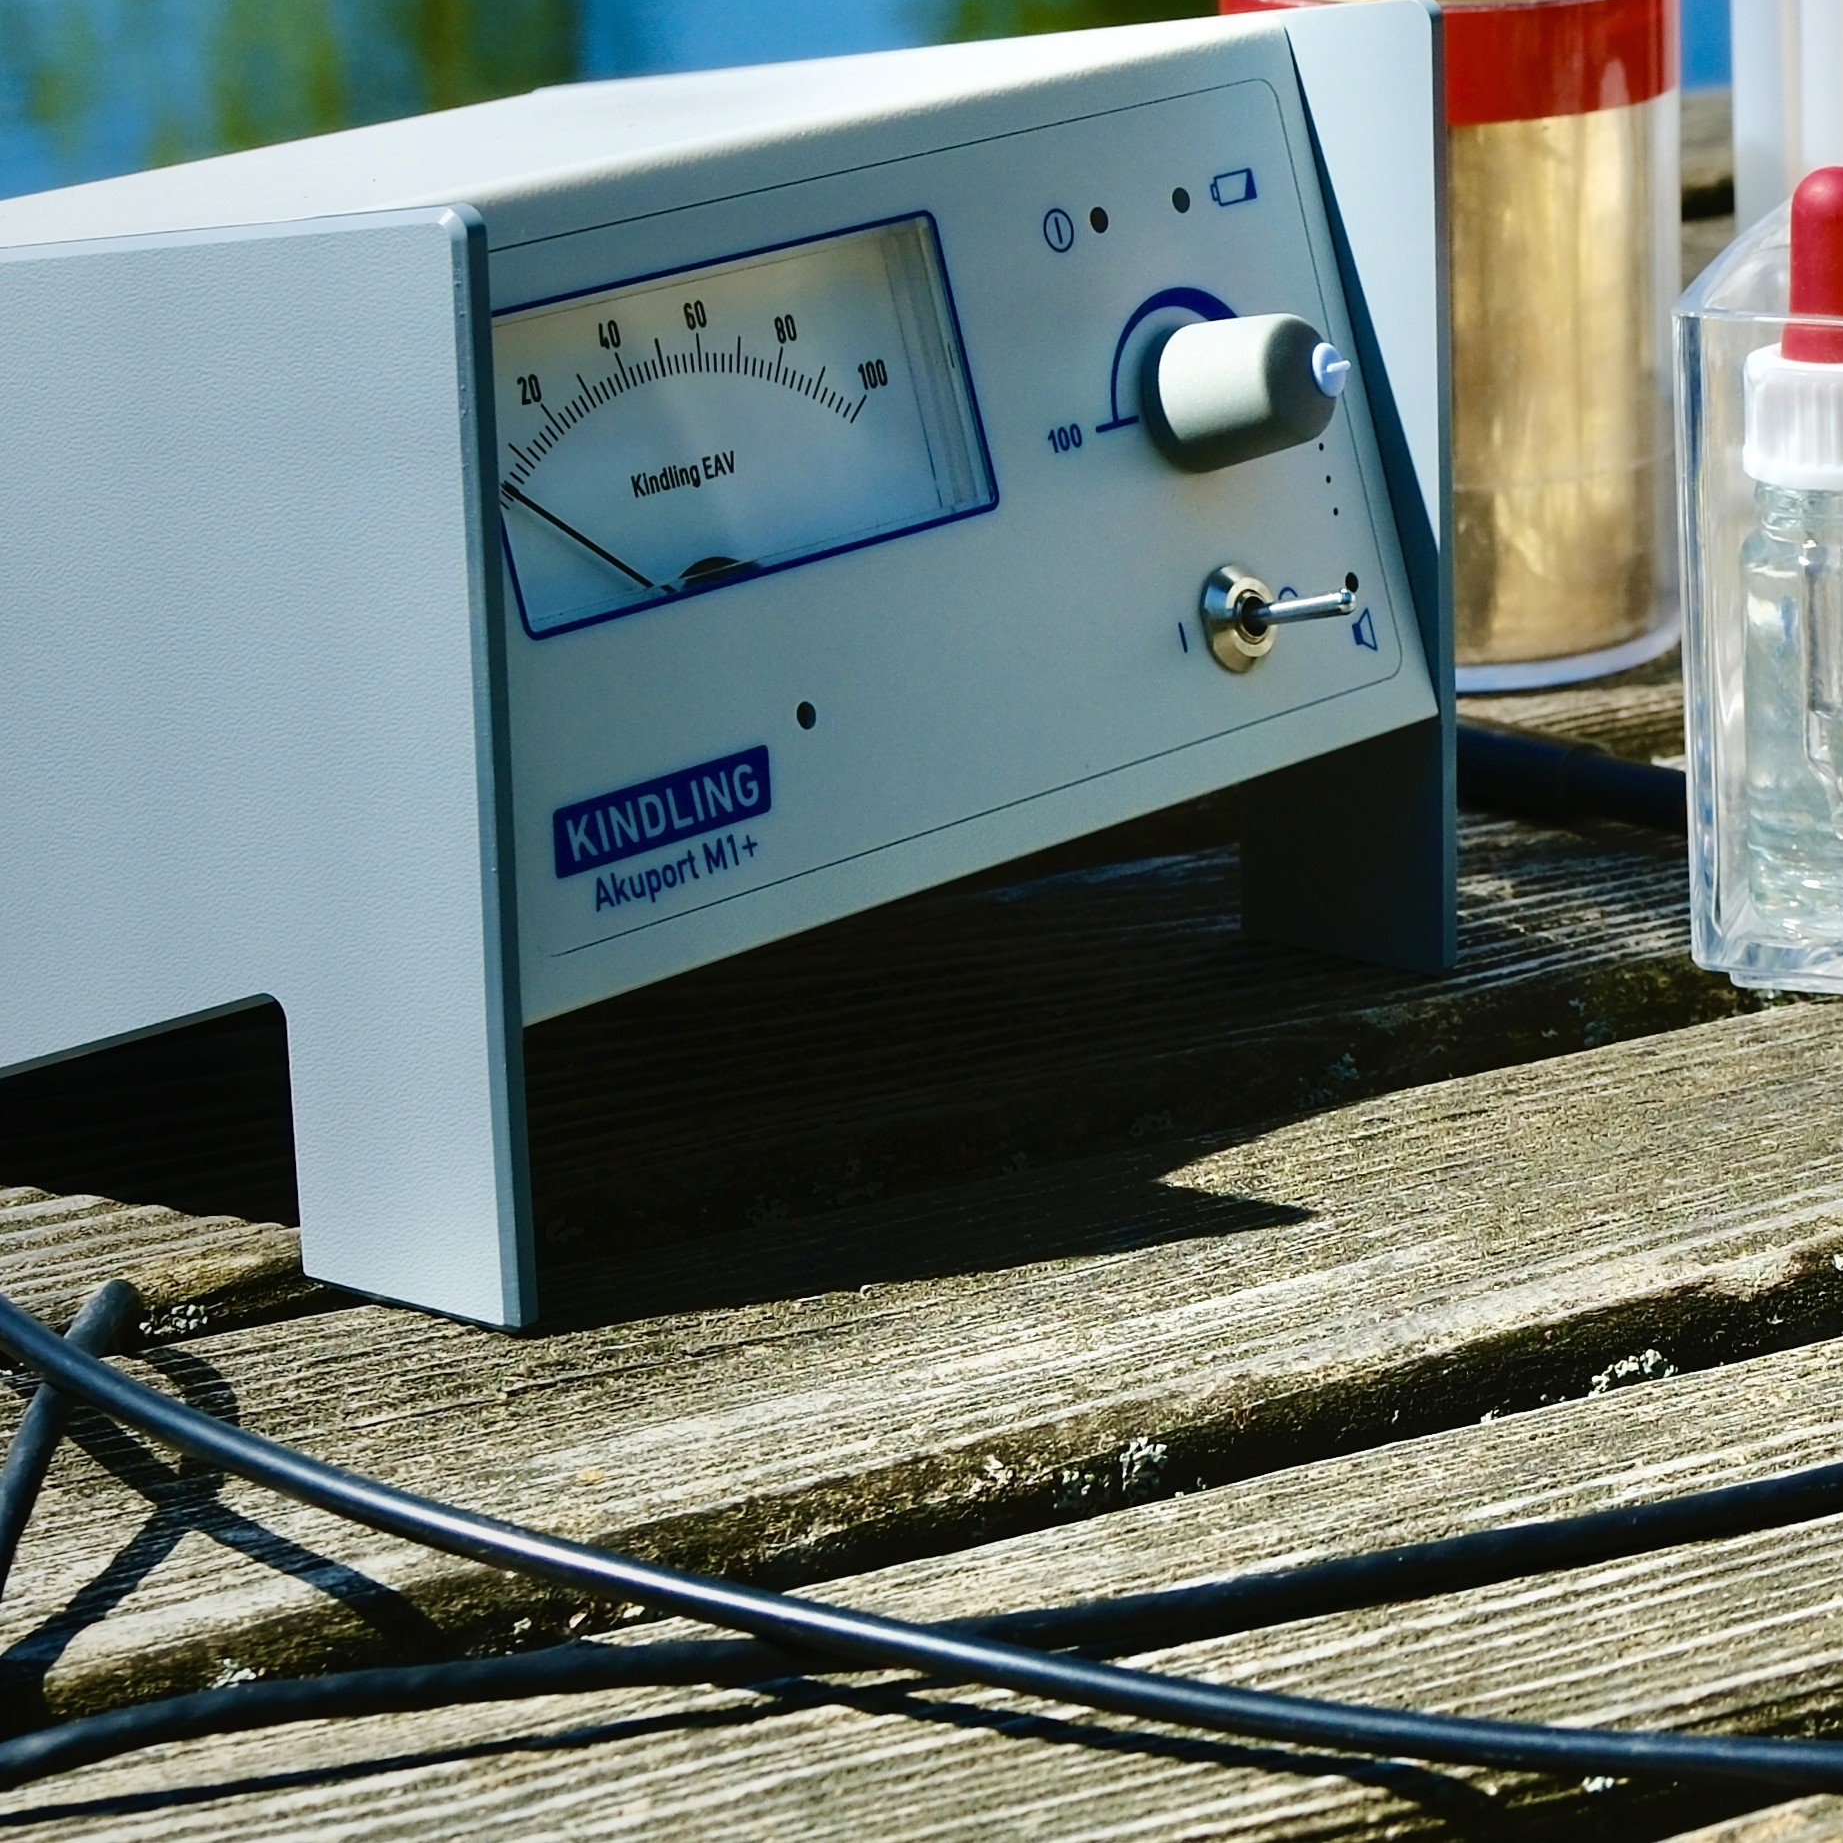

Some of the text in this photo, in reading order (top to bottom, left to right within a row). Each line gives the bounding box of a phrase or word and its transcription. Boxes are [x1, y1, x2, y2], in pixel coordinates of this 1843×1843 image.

[683, 300, 707, 331] 60
[774, 314, 797, 344] 80
[598, 319, 621, 350] 40
[517, 374, 541, 406] 20
[858, 359, 888, 391] 100
[1047, 423, 1083, 455] 100
[630, 450, 735, 498] Kindling EAV
[566, 763, 760, 863] KINDLING
[595, 833, 758, 912] Akuport M1+
